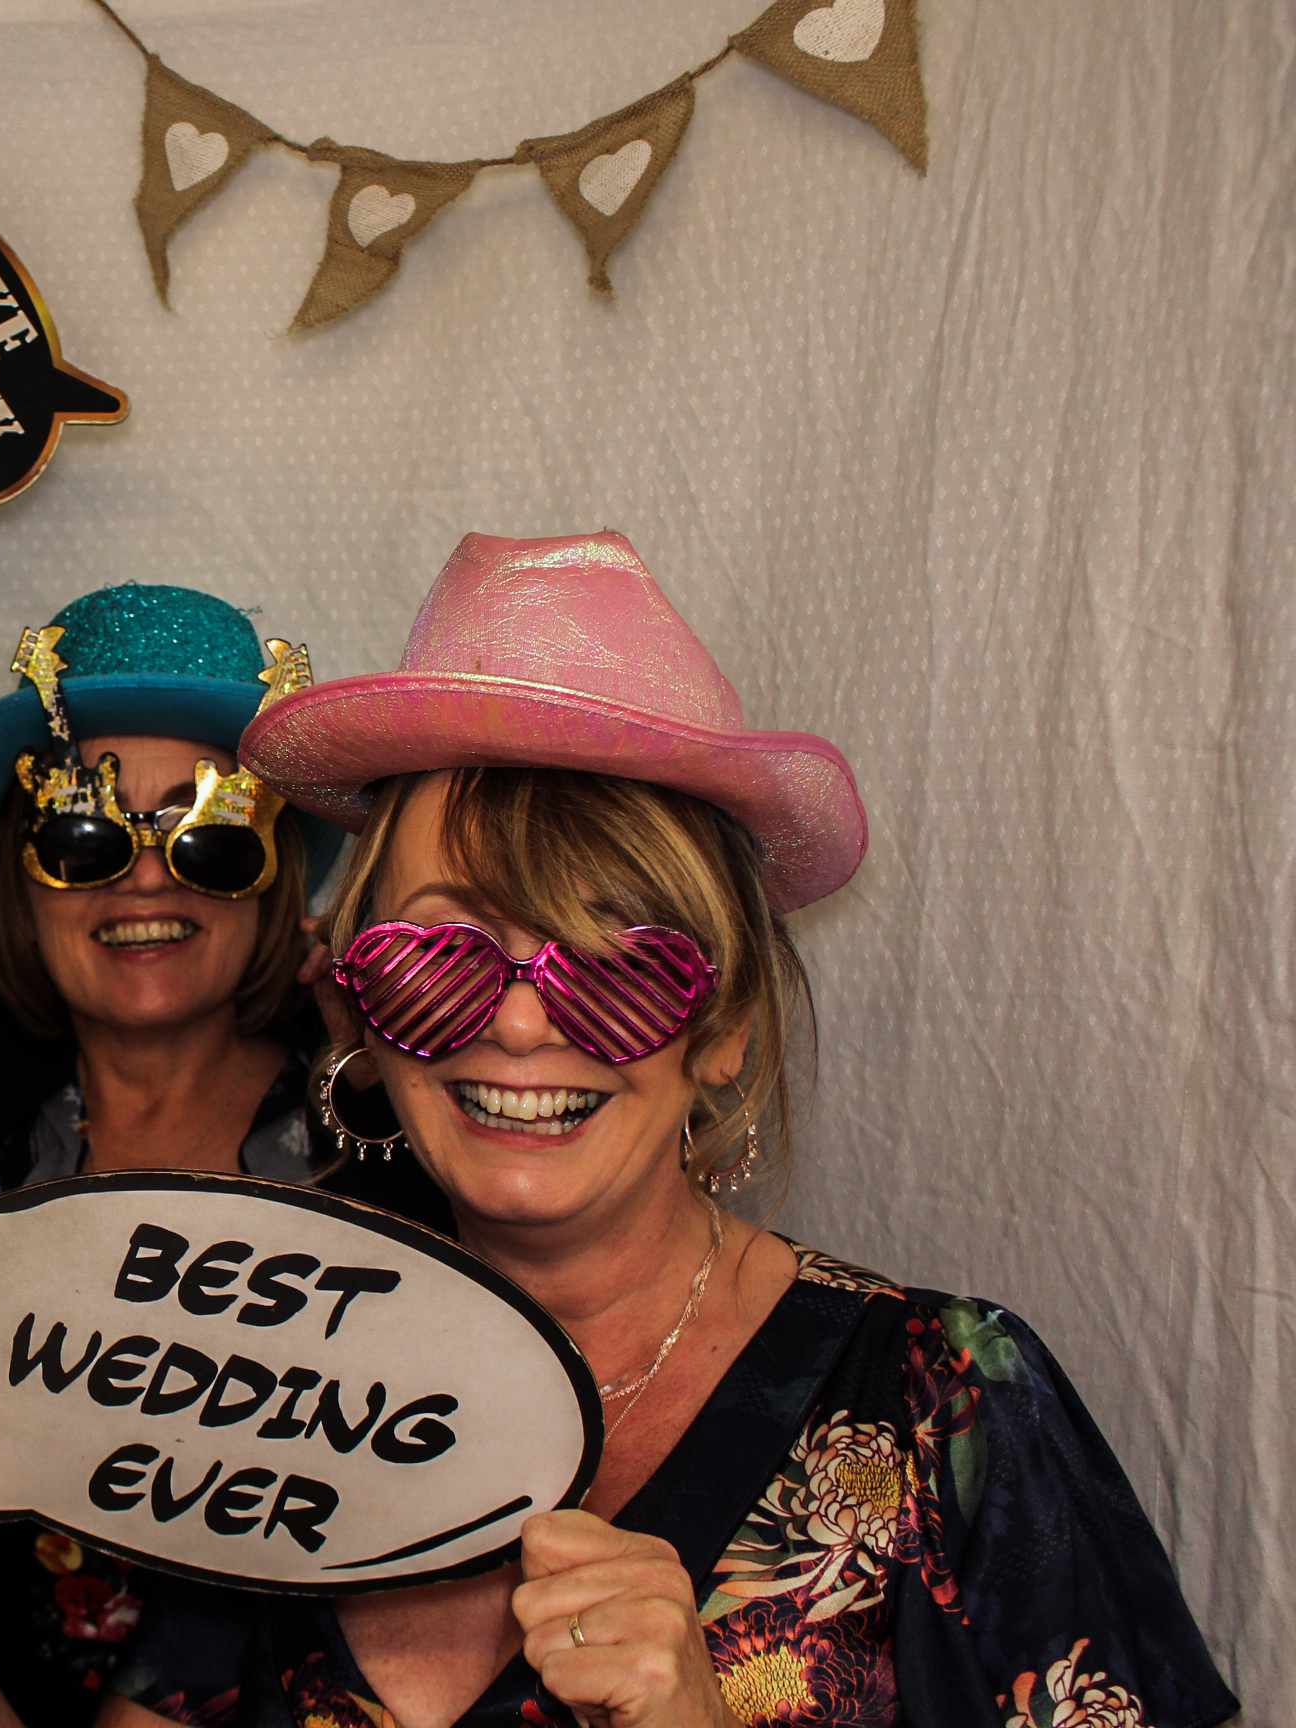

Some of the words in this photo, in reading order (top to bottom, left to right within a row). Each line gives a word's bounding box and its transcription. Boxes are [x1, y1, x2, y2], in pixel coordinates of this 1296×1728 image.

[114, 1223, 402, 1340] BEST
[9, 1312, 459, 1463] WEDDING
[88, 1443, 340, 1553] EVER
